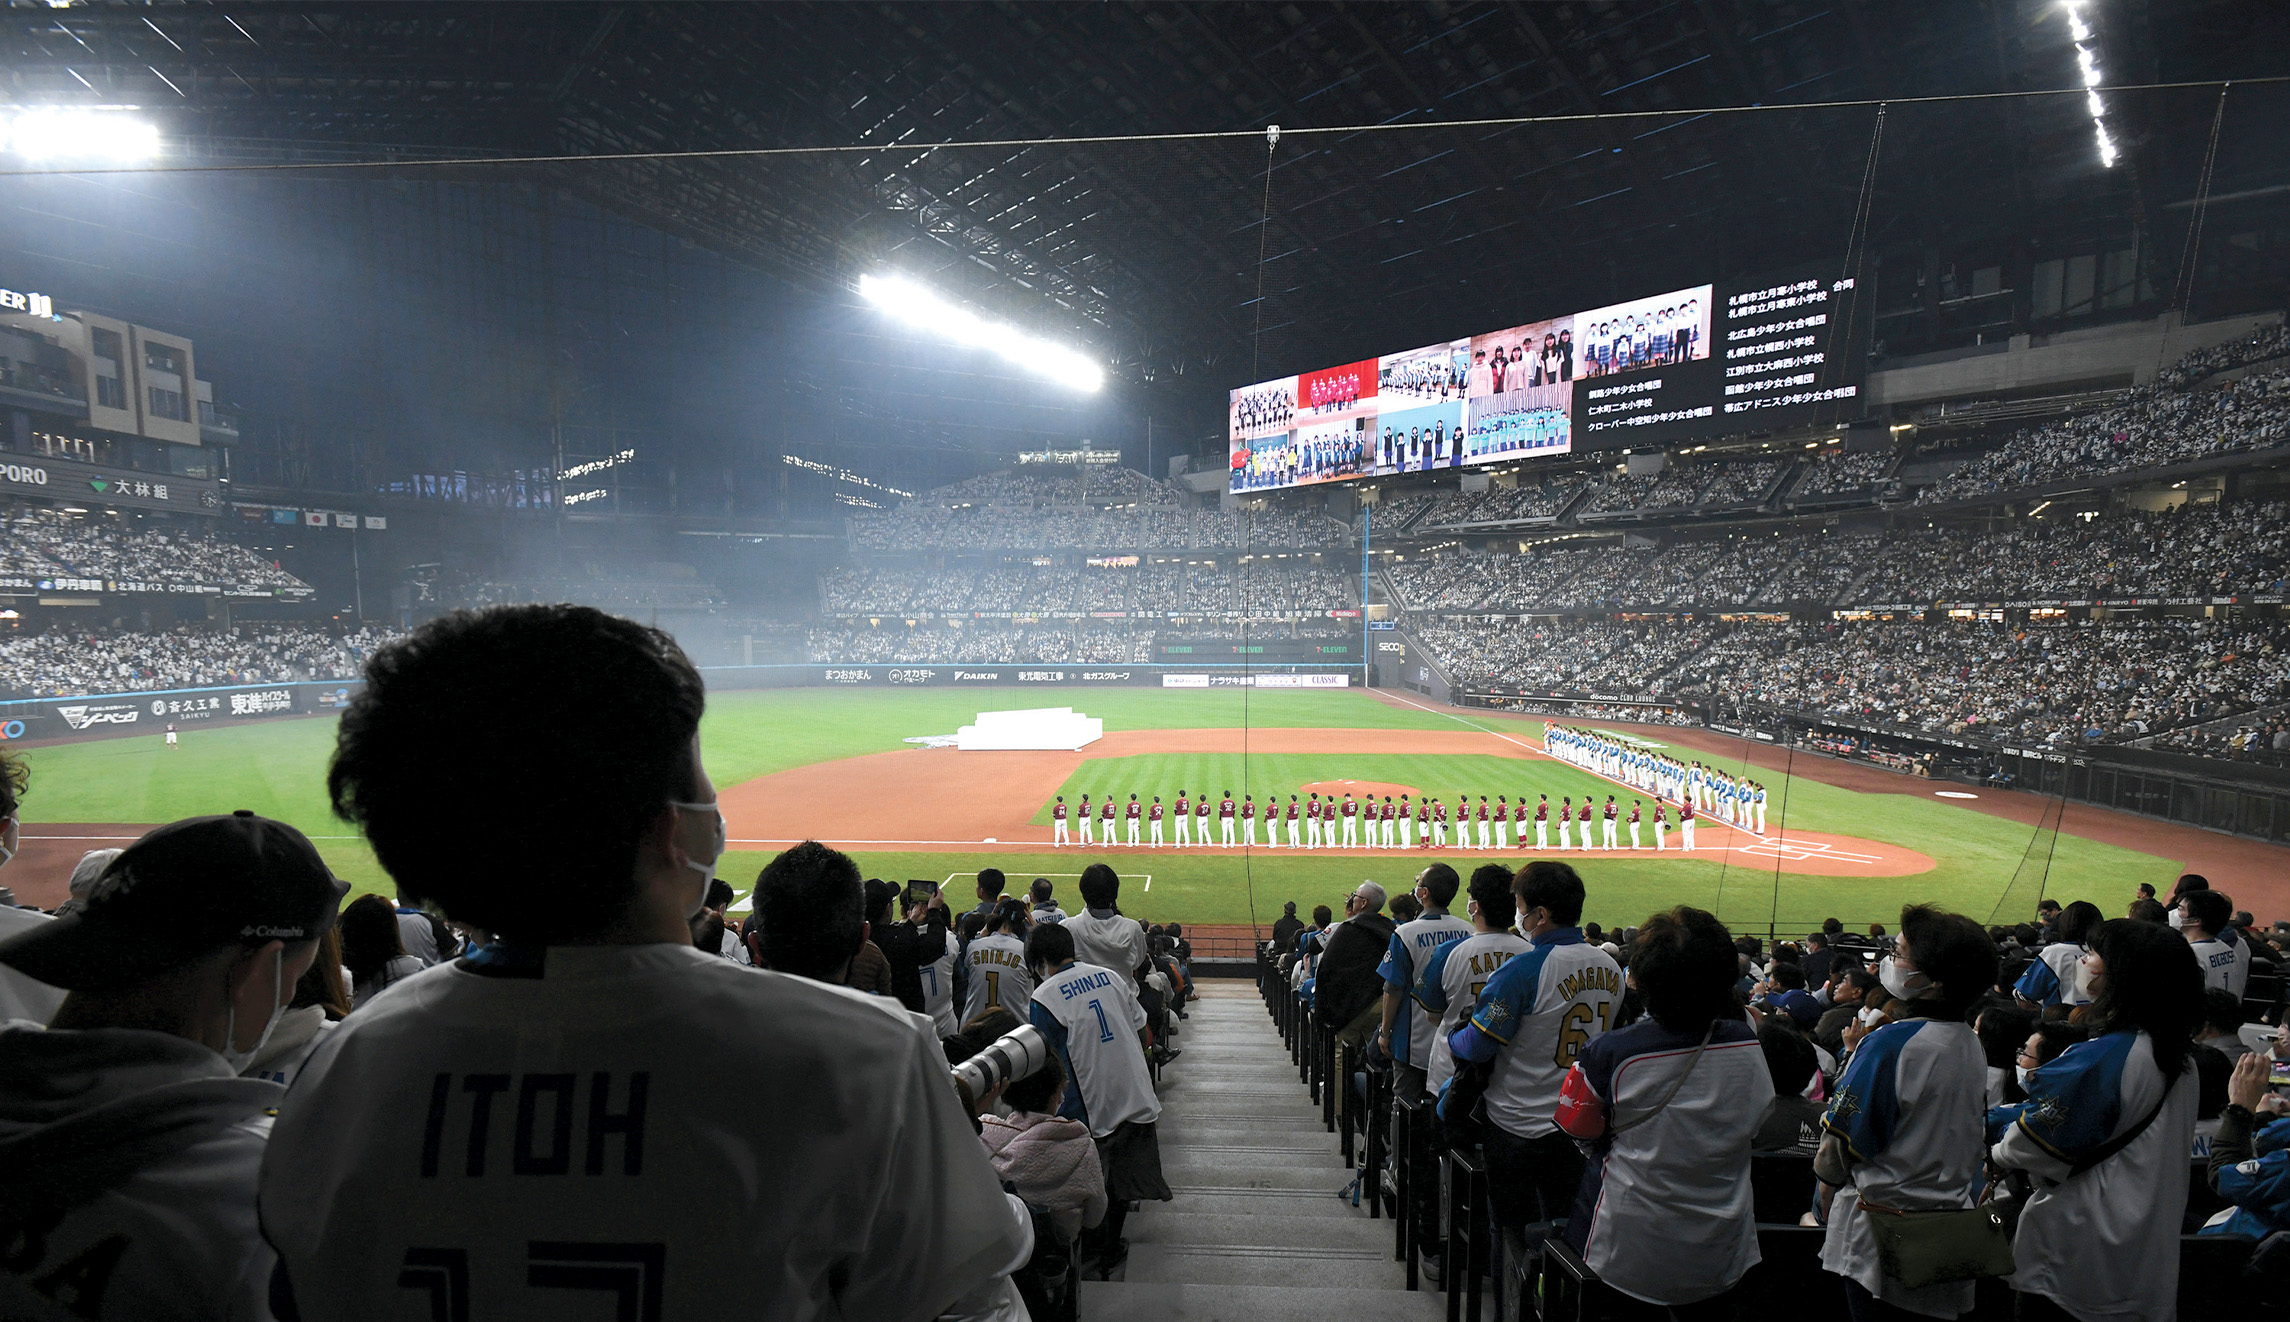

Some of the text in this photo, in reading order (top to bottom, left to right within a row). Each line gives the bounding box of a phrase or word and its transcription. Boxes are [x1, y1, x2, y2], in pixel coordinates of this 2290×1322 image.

[1833, 278, 1855, 292] 合同
[1727, 314, 1827, 341] 北広島少年少女合唱団
[1725, 352, 1824, 377] 江別市立大麻西小学校
[1724, 386, 1856, 413] 帯広アドニス少年少女合唱団
[1588, 406, 1713, 432] クローバー中空知少年少女合唱団
[115, 479, 169, 500] 大林組
[118, 582, 164, 592] 北海道バス
[825, 669, 871, 680] まつおかまん
[904, 669, 935, 678] オカモト
[1083, 672, 1130, 680] 北ガスグループ
[1311, 676, 1339, 684] CLASSIC
[230, 693, 263, 715] 東進
[79, 711, 139, 729] ジーベック
[180, 711, 210, 721] SAIKYU
[255, 925, 305, 938] Columbia
[973, 949, 1021, 969] SHINJO
[1059, 971, 1112, 1001] SHINJO
[1557, 967, 1620, 1002] IMAGAWA
[1088, 999, 1114, 1044] 1
[1553, 1001, 1611, 1069] 61
[420, 1071, 649, 1178] ITOH
